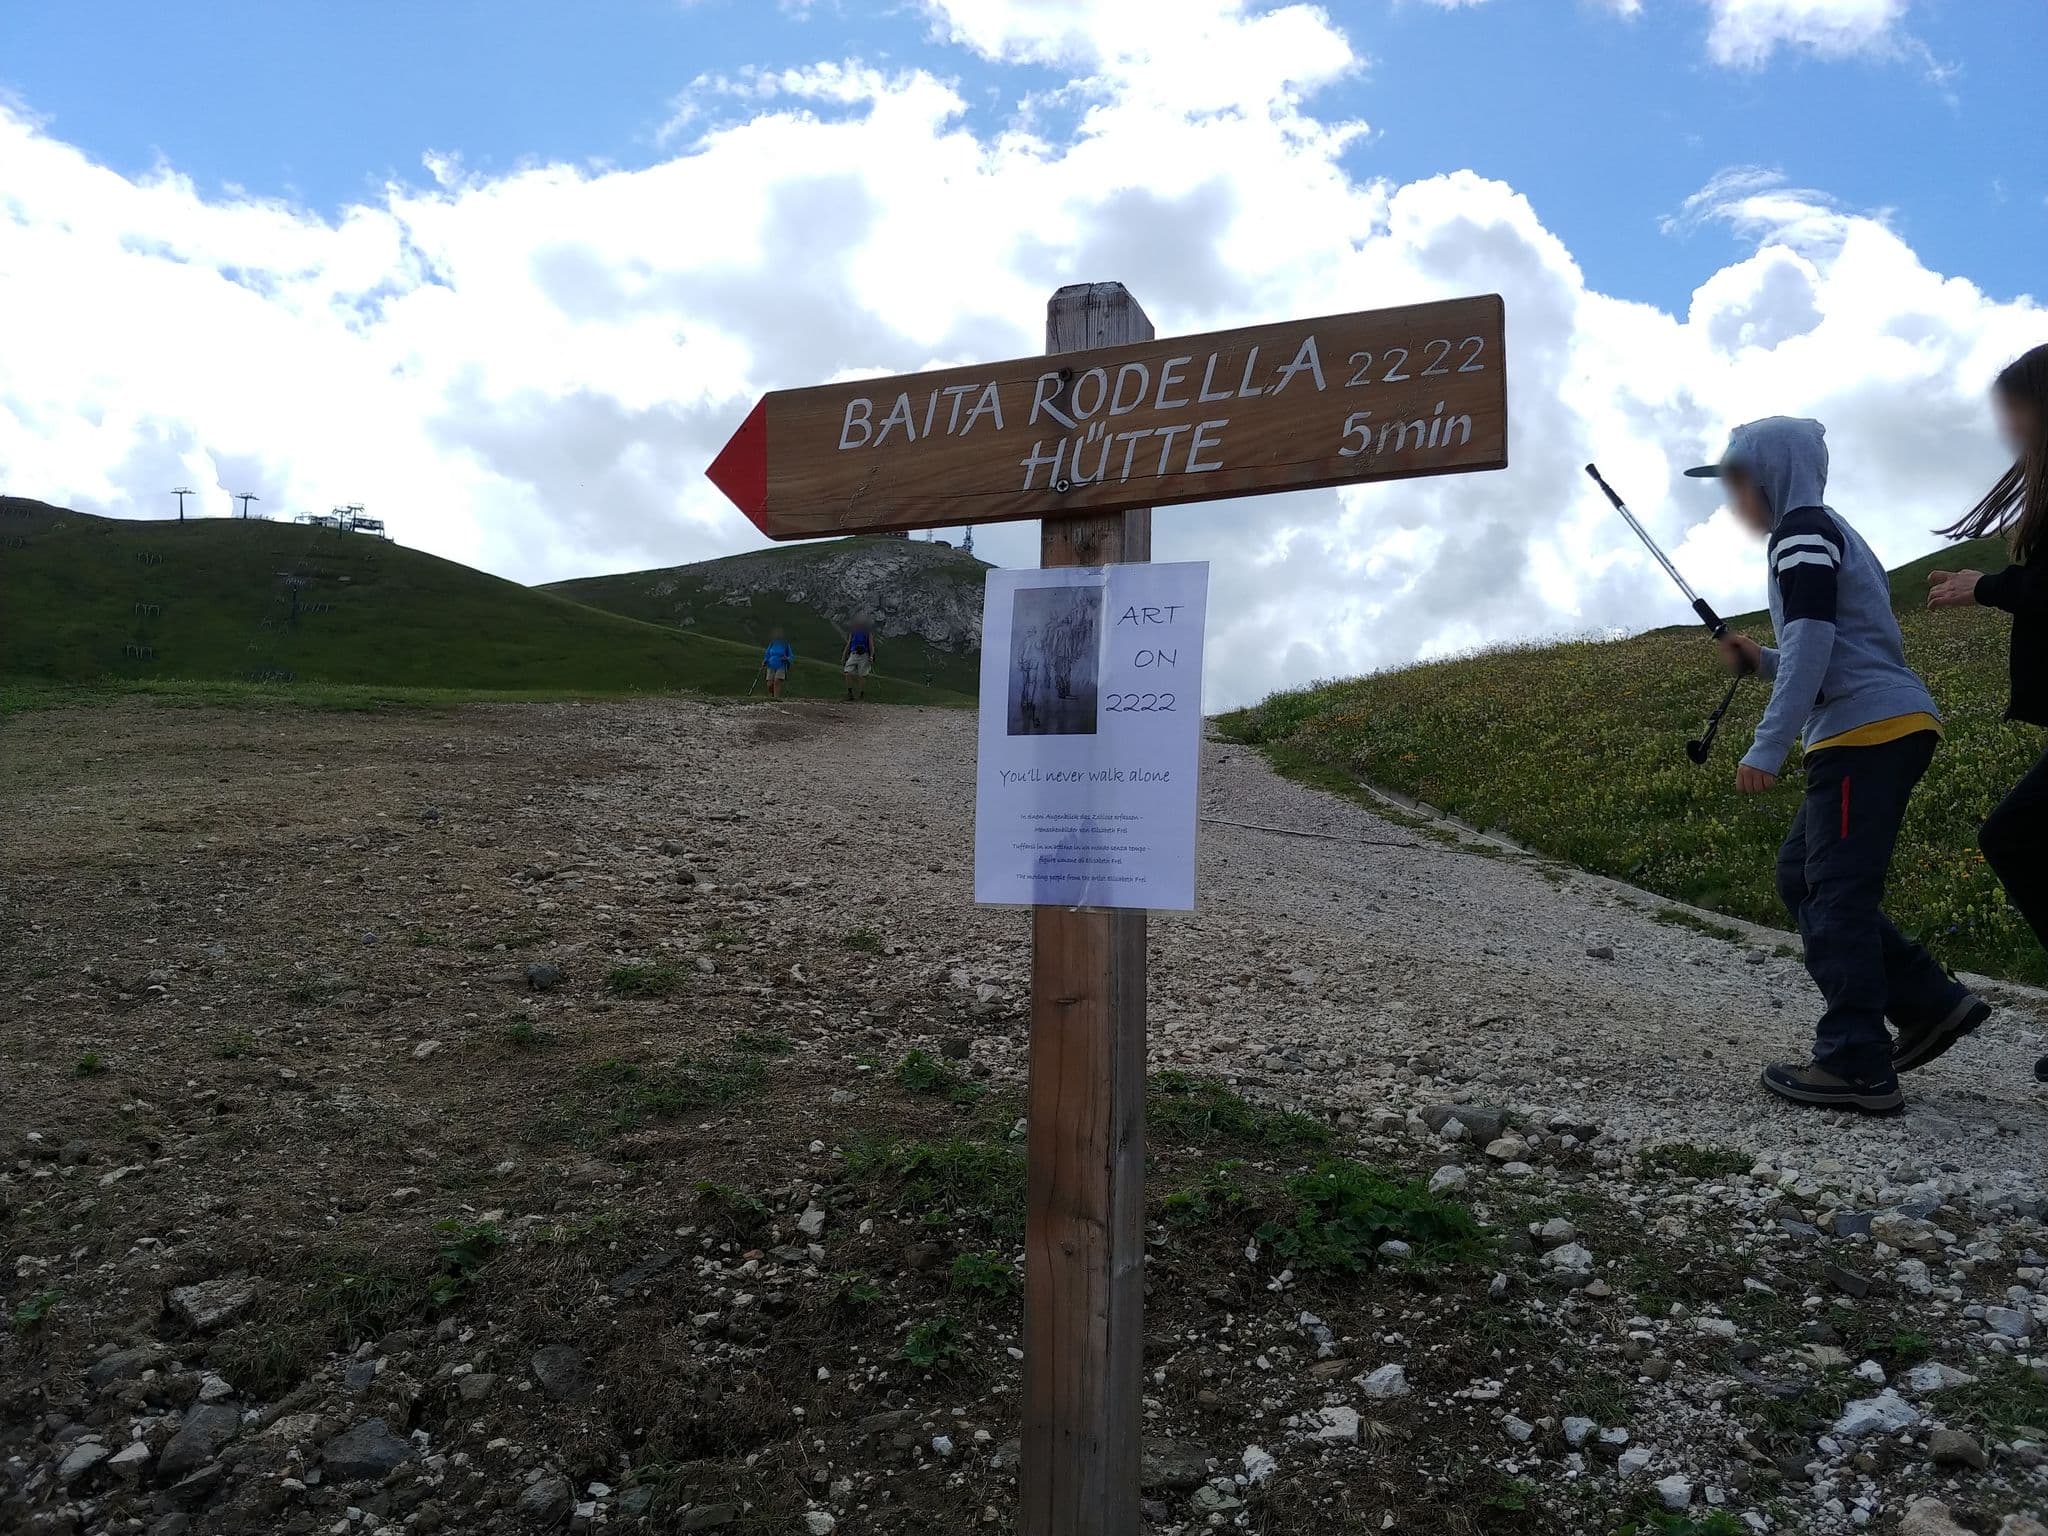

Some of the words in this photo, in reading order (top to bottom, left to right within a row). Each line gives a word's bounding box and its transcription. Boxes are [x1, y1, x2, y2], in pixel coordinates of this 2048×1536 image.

[838, 381, 1004, 450] BAITA
[1029, 335, 1327, 427] RODELLA
[1344, 335, 1485, 387] 2222
[1020, 419, 1229, 490] HÜTTE
[1117, 606, 1184, 626] ART
[1135, 649, 1177, 668] ON
[1105, 693, 1176, 712] 2222
[1000, 770, 1041, 788] You'll
[1046, 771, 1087, 782] never
[1089, 768, 1124, 782] walk
[1130, 770, 1169, 782] alone
